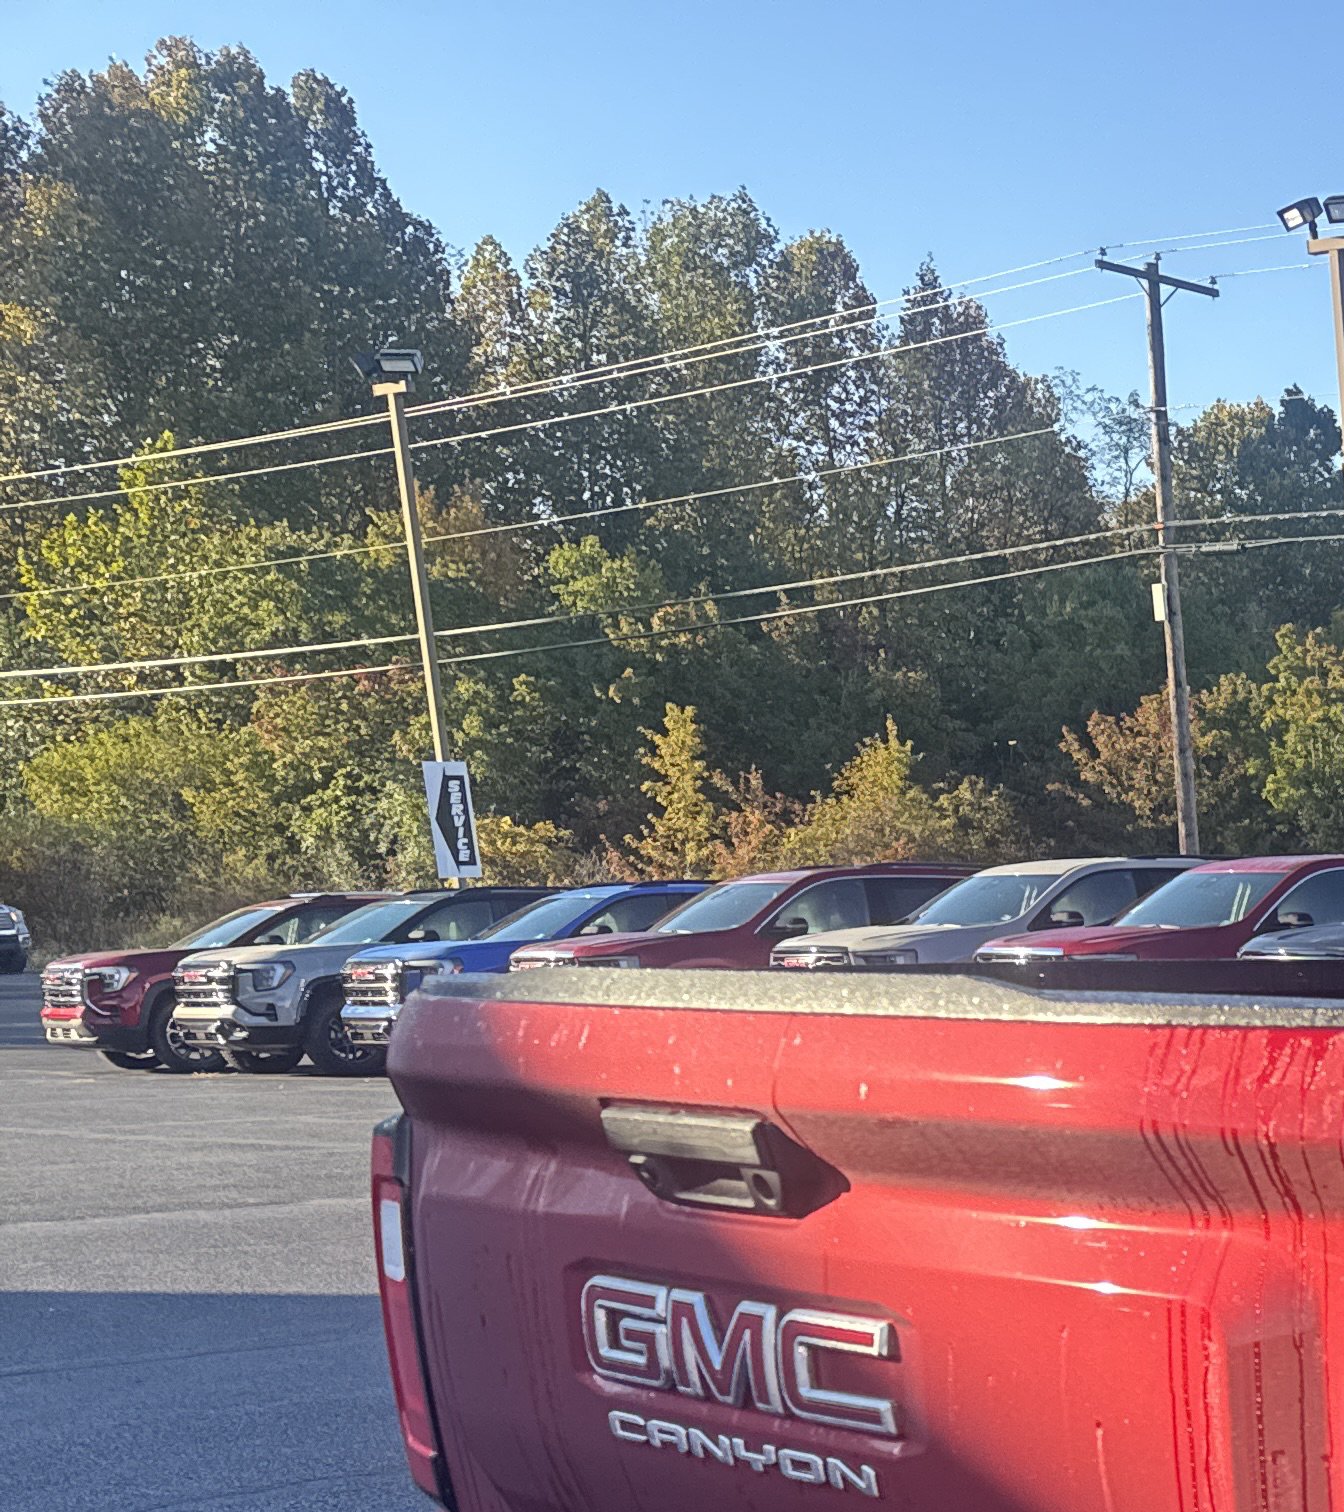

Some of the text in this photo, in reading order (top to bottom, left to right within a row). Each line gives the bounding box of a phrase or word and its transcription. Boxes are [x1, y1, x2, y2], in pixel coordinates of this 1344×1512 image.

[447, 779, 470, 862] SERVICE
[581, 1275, 898, 1435] GMC
[608, 1409, 880, 1498] CANYON
